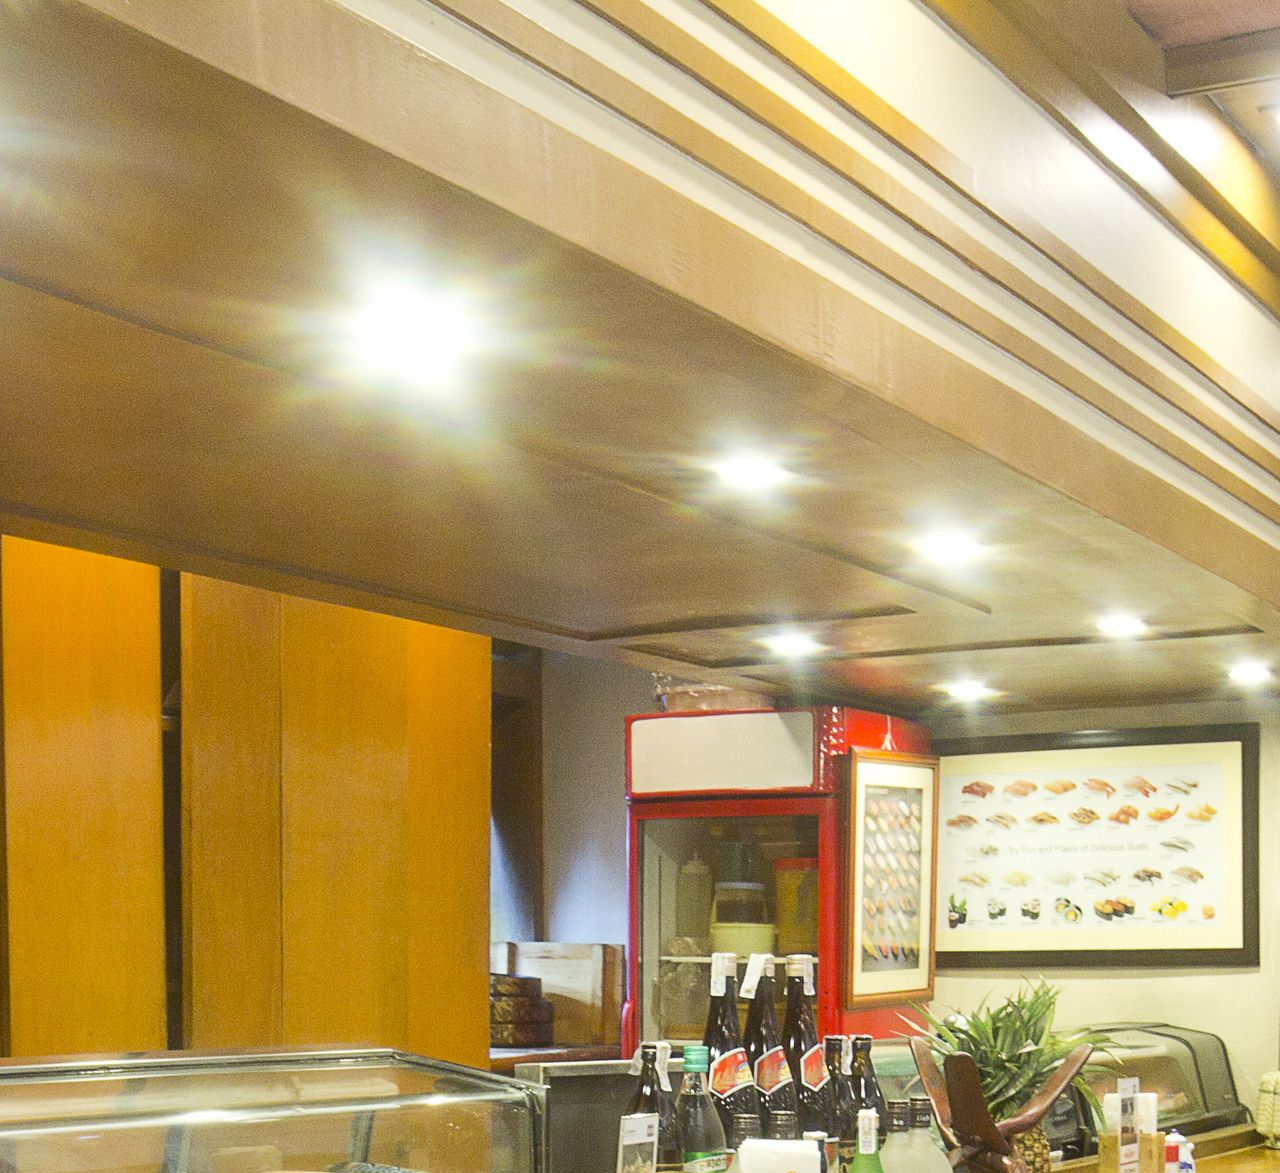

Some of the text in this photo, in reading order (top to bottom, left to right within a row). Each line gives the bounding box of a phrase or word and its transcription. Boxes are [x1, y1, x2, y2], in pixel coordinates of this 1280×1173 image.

[1038, 844, 1053, 854] and
[1054, 843, 1079, 854] Flavor
[1080, 843, 1088, 853] of
[1089, 842, 1125, 853] Delicious
